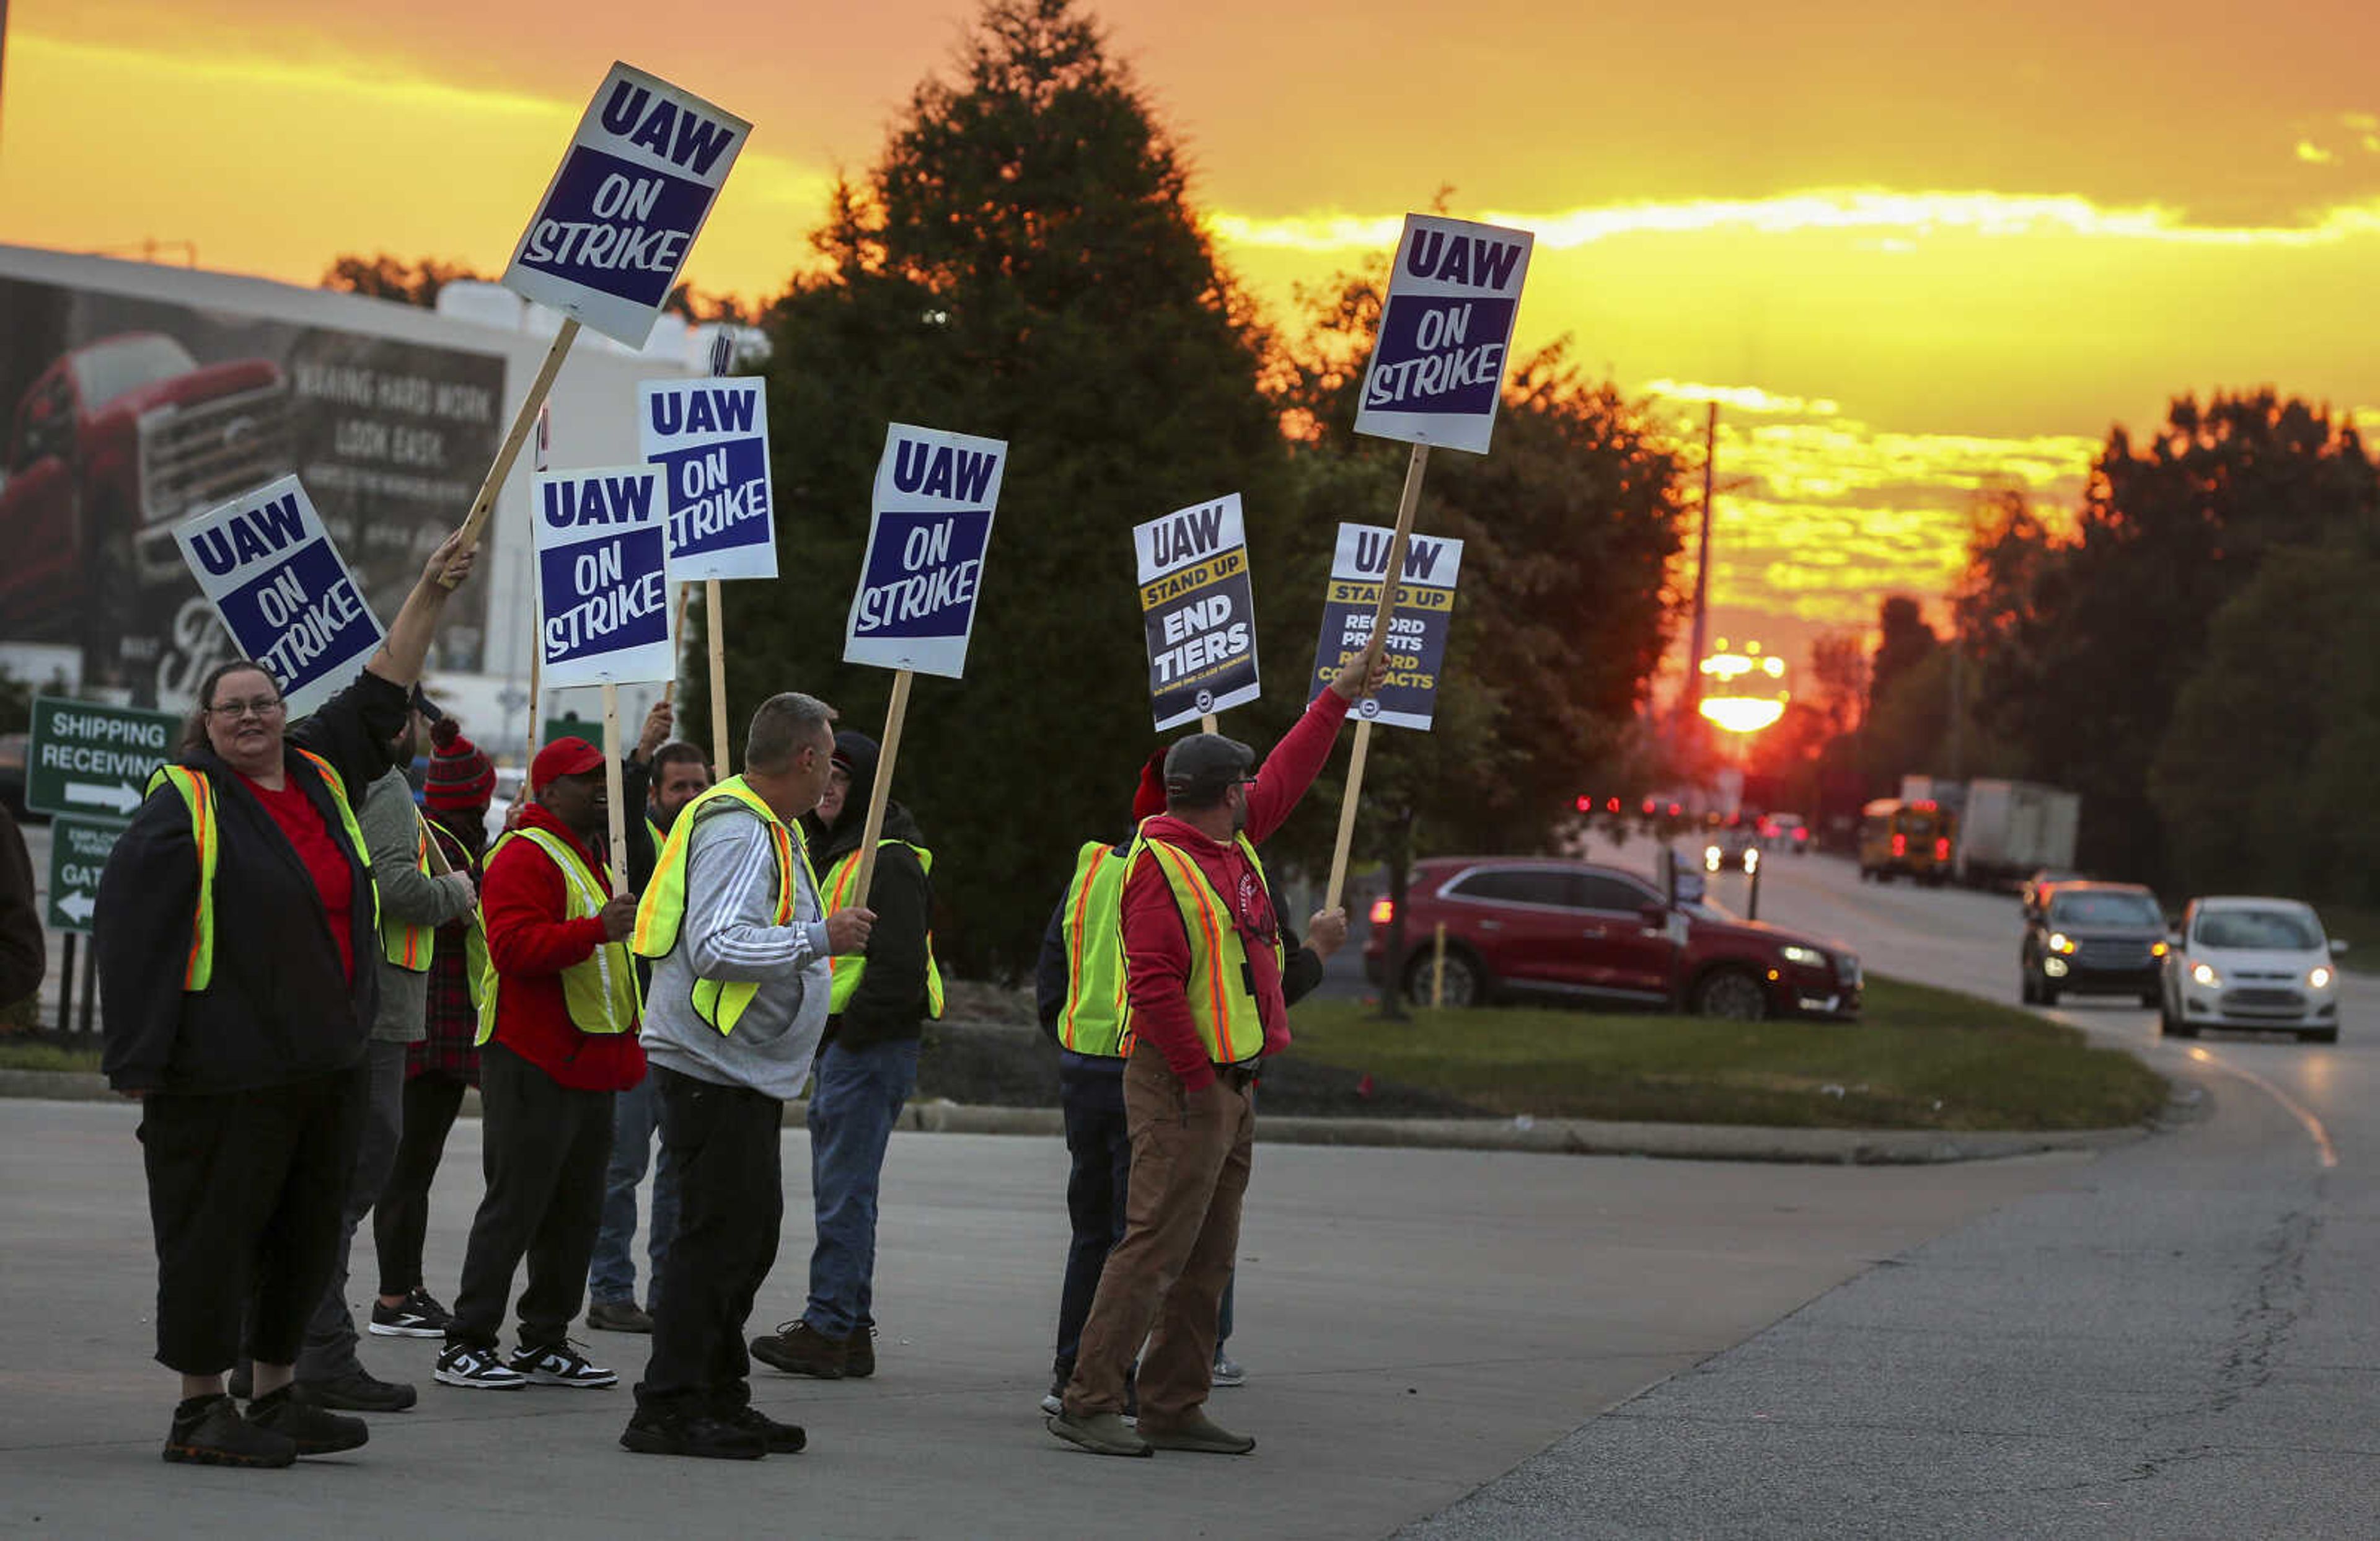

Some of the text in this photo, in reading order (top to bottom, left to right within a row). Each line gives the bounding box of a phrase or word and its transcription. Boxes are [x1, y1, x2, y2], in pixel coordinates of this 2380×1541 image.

[601, 79, 735, 176] UAW
[592, 172, 664, 222] ON
[523, 218, 690, 272] STRIKE
[1407, 229, 1522, 290] UAW
[1416, 303, 1471, 351] ON
[1368, 343, 1503, 405] STRIKE
[651, 389, 757, 435] UAW
[682, 448, 727, 498] ON
[894, 439, 997, 503] UAW
[543, 475, 655, 528] UAW
[669, 478, 766, 553] TRIKE
[190, 493, 306, 575] UAW
[903, 518, 954, 572] ON
[1152, 505, 1223, 568] UAW
[575, 540, 621, 596] ON
[857, 559, 979, 632] STRIKE
[1147, 555, 1240, 605] STAND UP
[257, 565, 308, 627] ON
[545, 570, 664, 659] STRIKE
[1163, 594, 1232, 645] END
[1336, 586, 1445, 607] STAD UP
[1154, 622, 1250, 682] TIERS
[52, 712, 165, 748] SHIPPING
[42, 744, 169, 776] RECEIVIN
